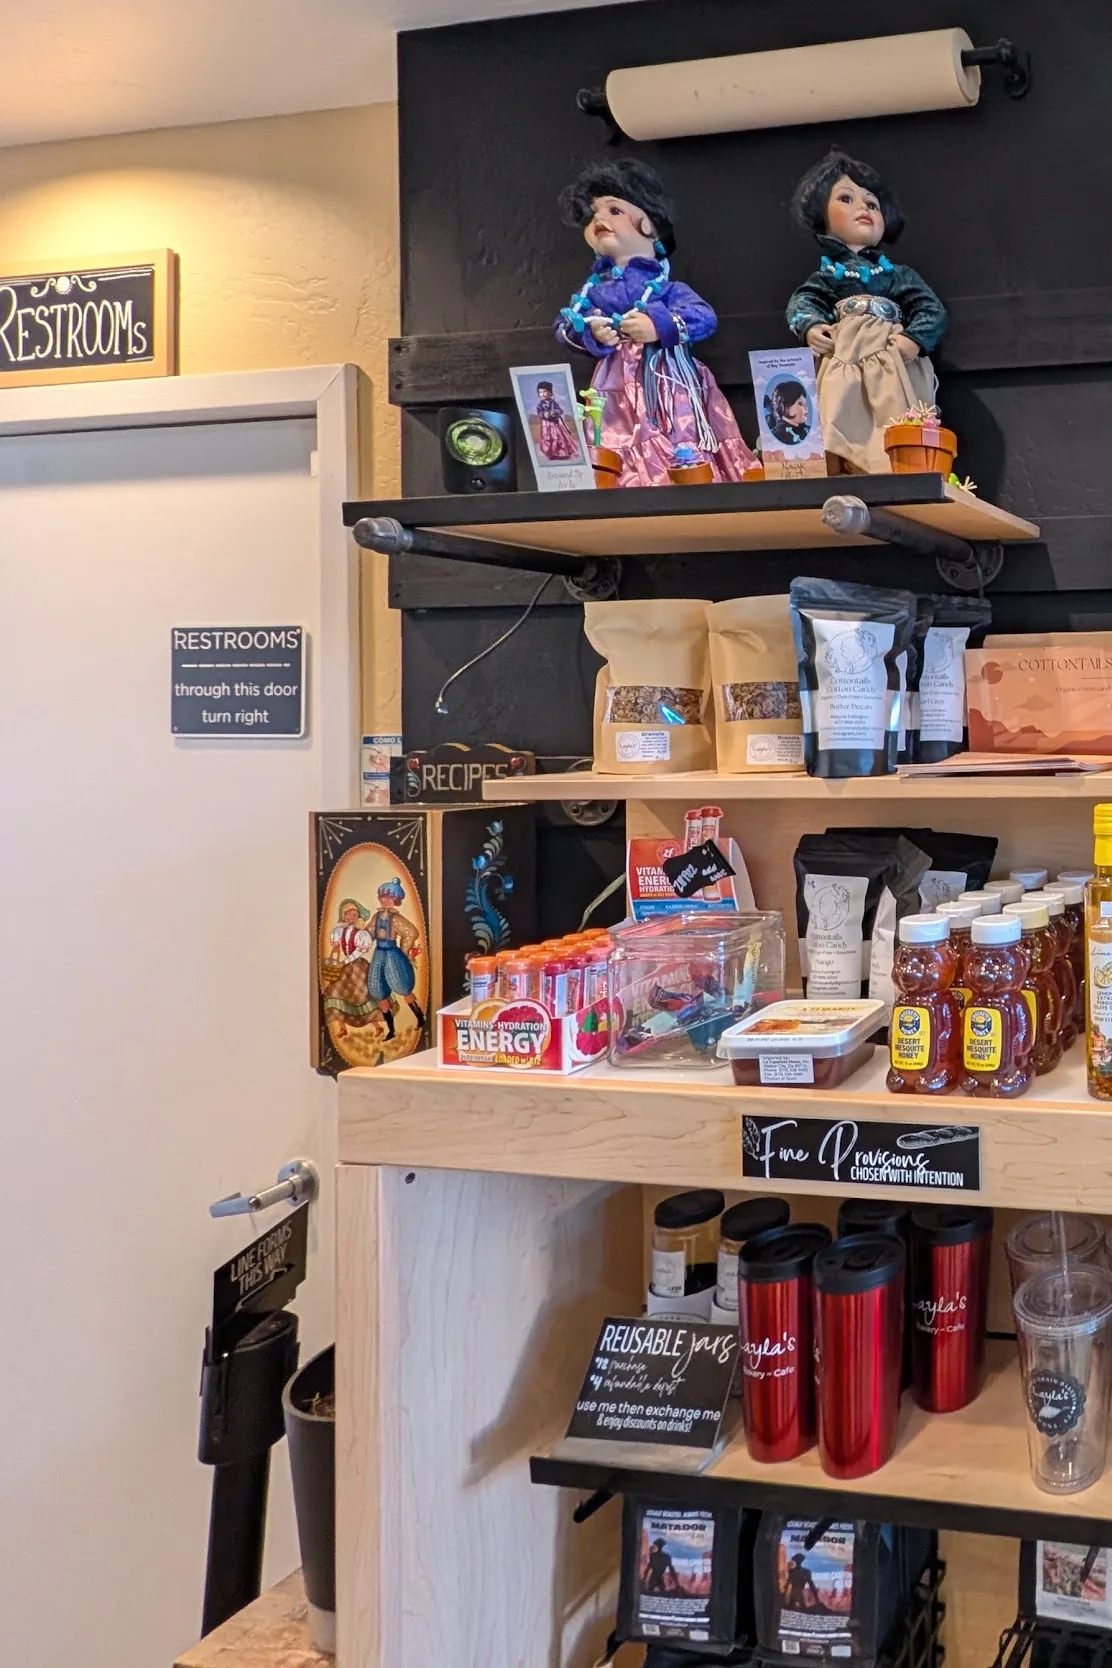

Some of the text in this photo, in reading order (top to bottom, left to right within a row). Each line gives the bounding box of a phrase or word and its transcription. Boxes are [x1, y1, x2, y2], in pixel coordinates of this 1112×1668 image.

[174, 631, 298, 650] RESTROOMS
[175, 682, 298, 699] through this door
[202, 709, 270, 725] turn right
[455, 1019, 547, 1032] VITAMINS HYDRATION
[456, 1029, 547, 1054] ENERGY
[895, 1044, 925, 1053] MESQUITE
[897, 1037, 921, 1045] DESERT
[966, 1046, 997, 1054] MESQUITE
[898, 1052, 919, 1060] HONEY
[970, 1053, 991, 1061] HONEY
[760, 1120, 930, 1181] Fine Provisions
[850, 1165, 964, 1187] CHOSEN WITH INTENTION
[230, 1220, 294, 1283] LINE FORMS
[238, 1243, 289, 1296] THIS WAY
[913, 1291, 968, 1326] ayla's
[599, 1323, 738, 1378] REUSABLE jars
[740, 1332, 797, 1370] ayla's
[1032, 1388, 1069, 1407] Layla's
[576, 1401, 722, 1422] use me then exchange me
[603, 1416, 623, 1431] enjoy
[623, 1417, 657, 1430] discounts
[656, 1420, 668, 1430] on
[667, 1418, 693, 1433] drinks!
[650, 1521, 707, 1533] MATADOR
[790, 1534, 847, 1545] MAADOR
